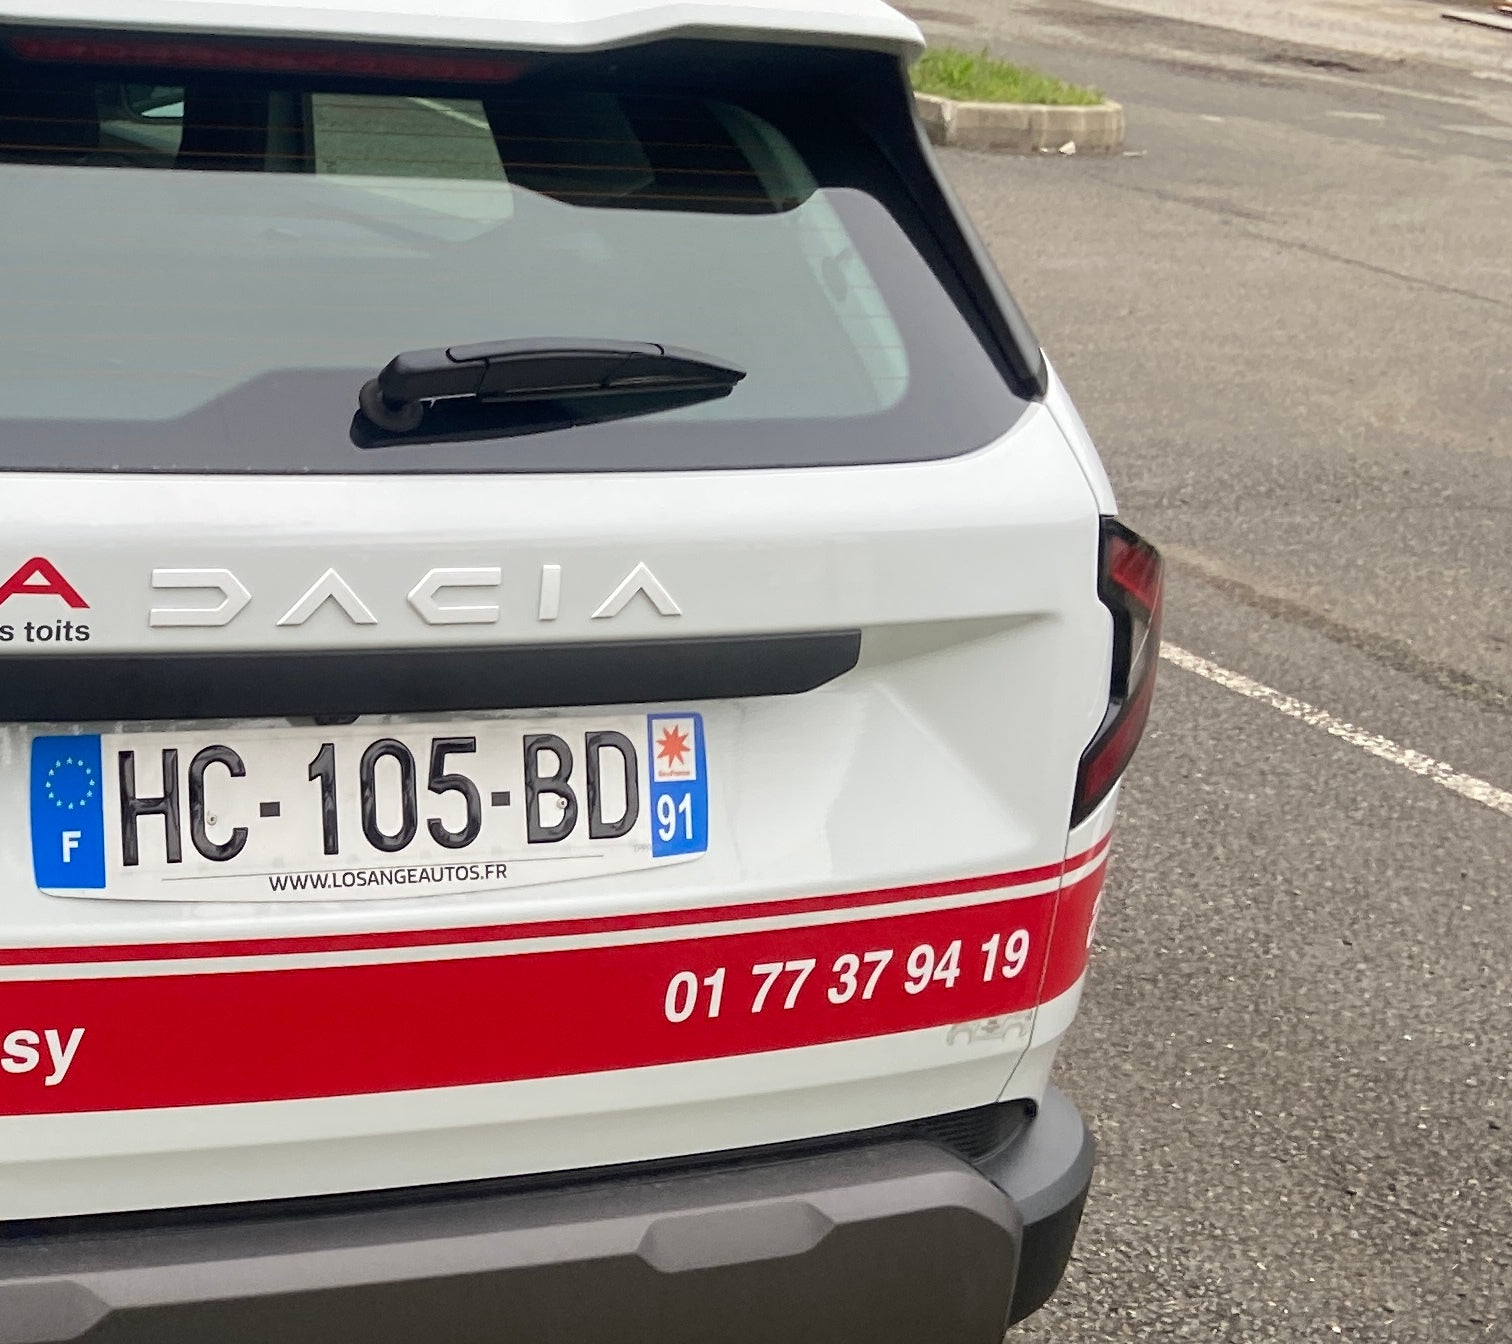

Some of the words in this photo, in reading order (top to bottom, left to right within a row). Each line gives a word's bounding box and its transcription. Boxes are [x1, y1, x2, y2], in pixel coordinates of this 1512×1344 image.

[149, 561, 682, 627] DACIA
[23, 618, 90, 643] toits
[118, 730, 639, 866] HC-105-BD
[657, 792, 693, 842] 91
[62, 830, 82, 862] F
[268, 863, 508, 892] WWW.LOSANGEAUTOS.FR
[664, 967, 726, 1023] 01
[750, 958, 816, 1013] 77
[827, 949, 893, 1004] 37
[903, 940, 963, 995] 94
[980, 929, 1030, 981] 19
